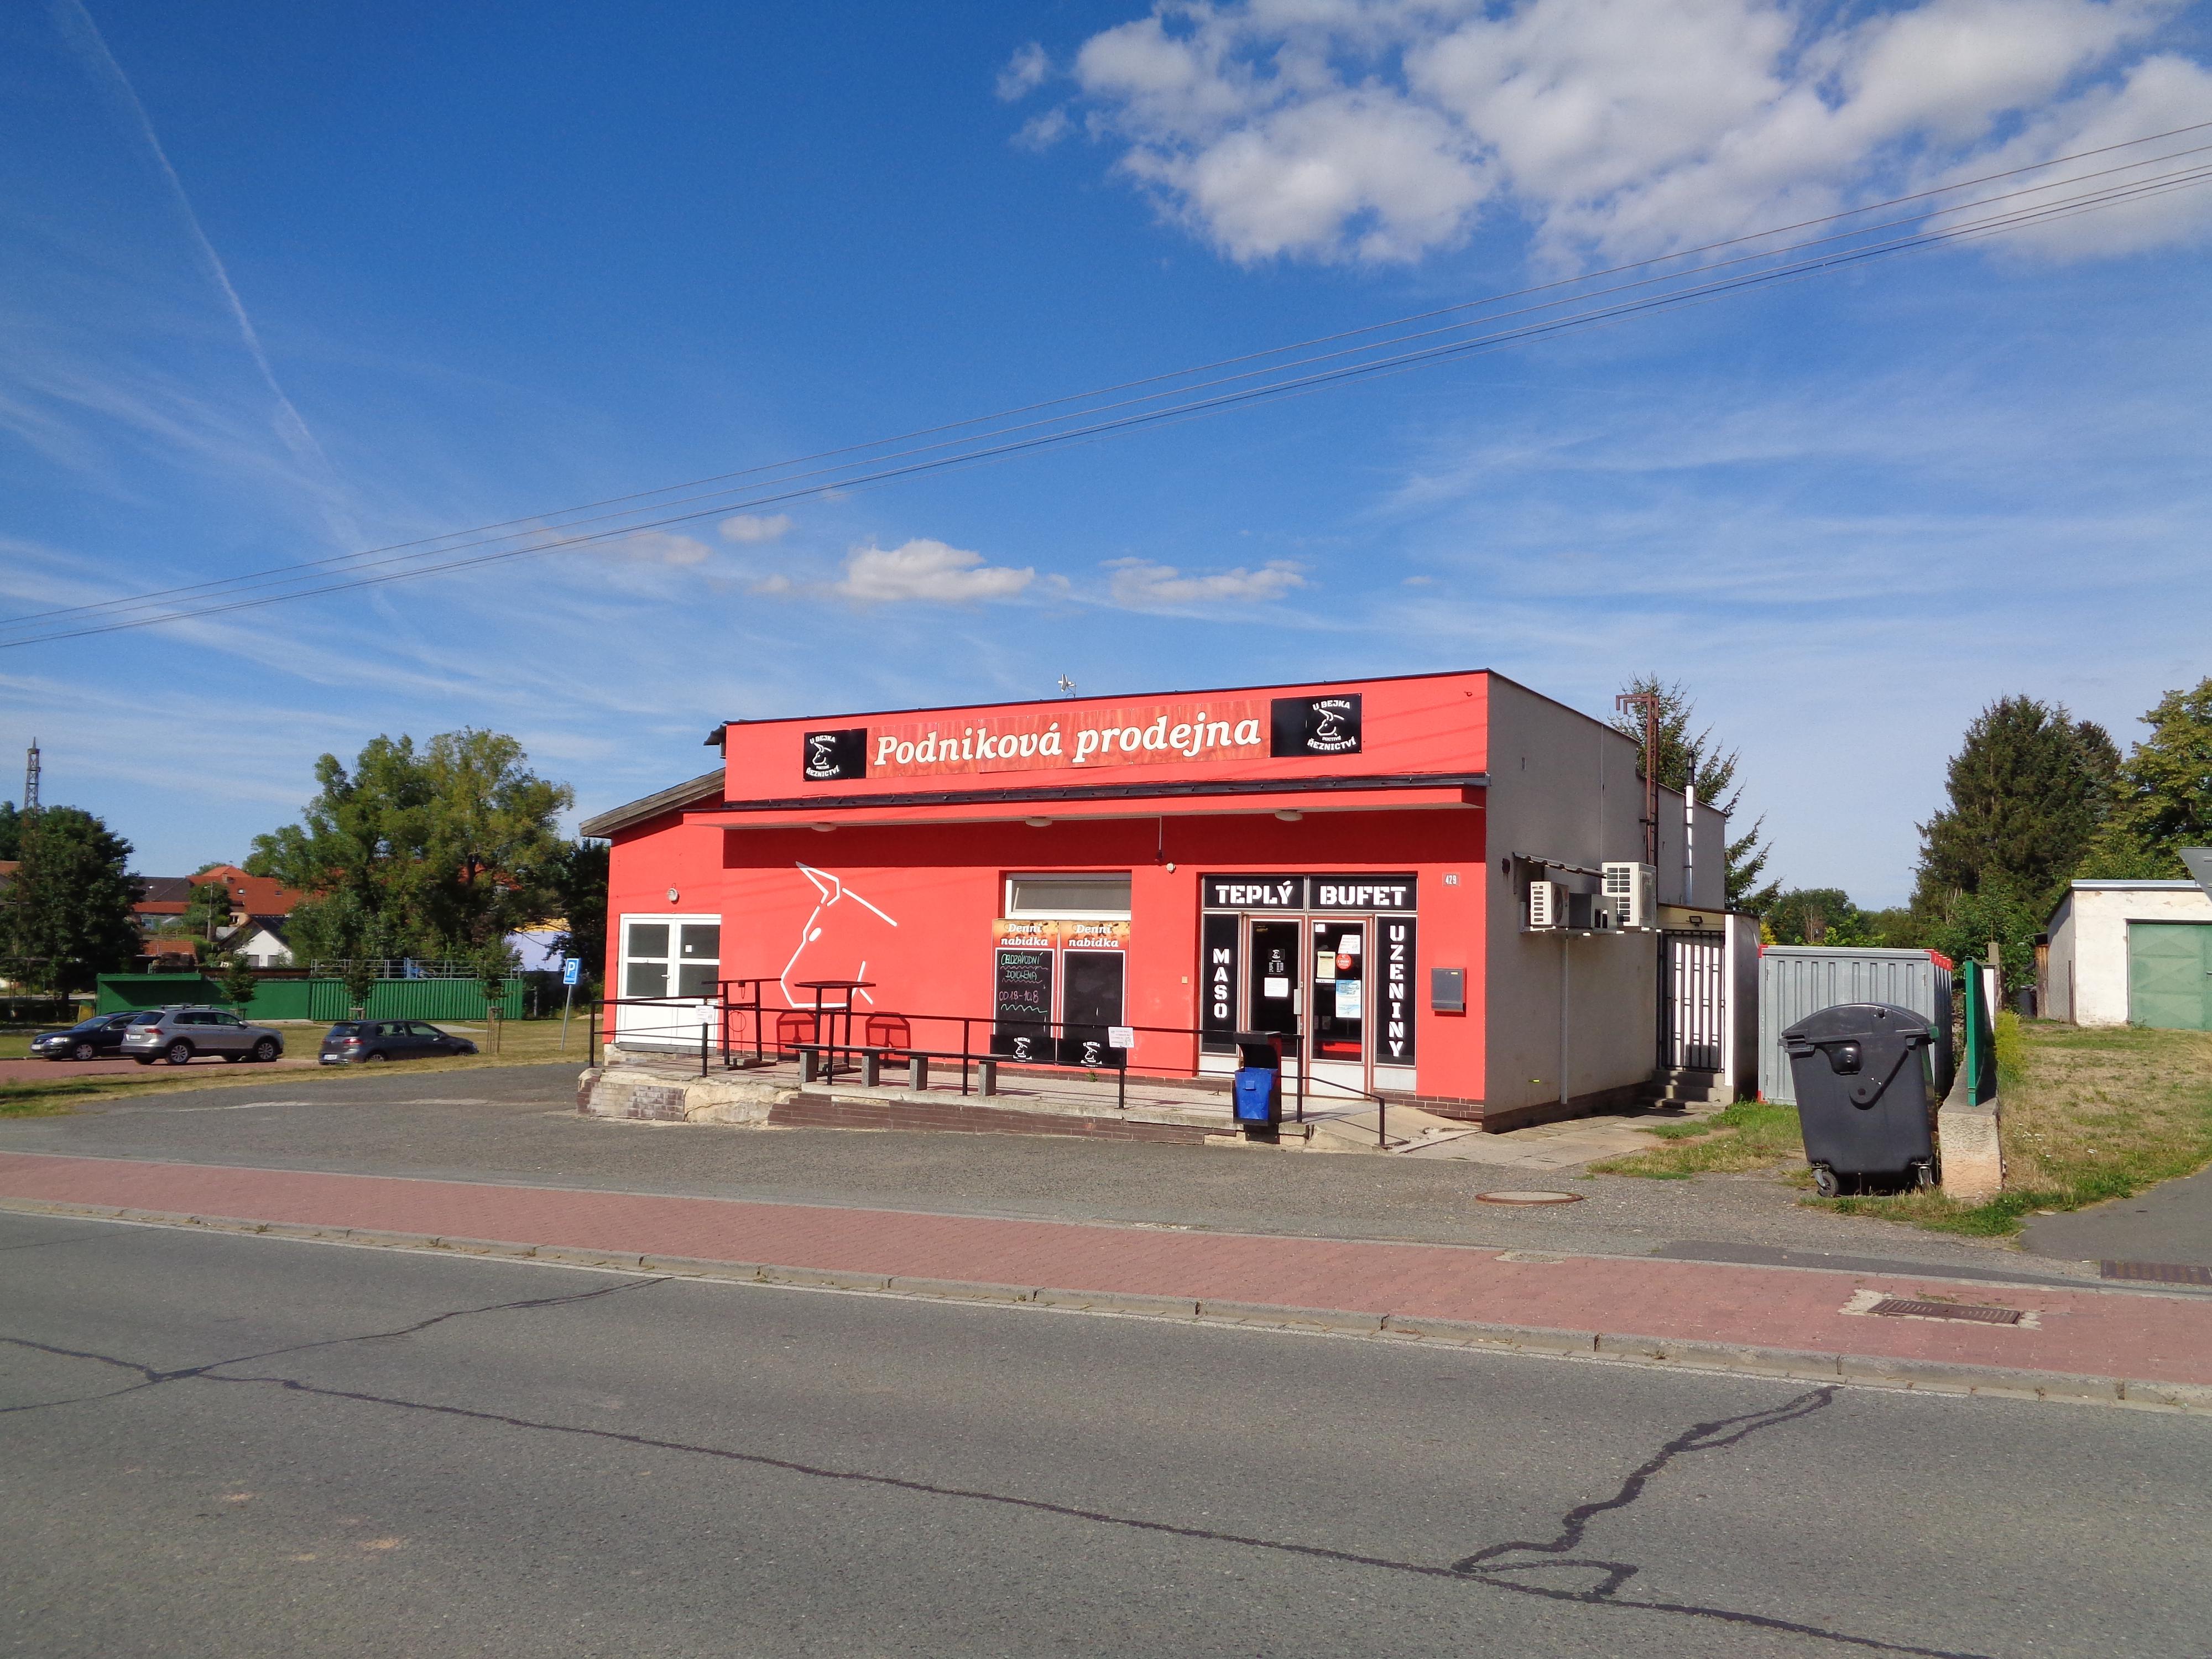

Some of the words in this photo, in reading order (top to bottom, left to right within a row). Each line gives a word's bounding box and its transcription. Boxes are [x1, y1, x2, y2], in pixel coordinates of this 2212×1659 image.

[1321, 700, 1350, 709] BEJKA
[874, 722, 1062, 766] Podniková
[1072, 711, 1261, 763] prodejna
[1307, 736, 1356, 750] ŘEZNICTVÍ
[806, 765, 839, 777] ŘEZNICTVÍ
[1445, 875, 1457, 884] 429
[1215, 880, 1293, 904] TEPLÝ
[1319, 886, 1407, 905] BUFET
[567, 962, 576, 976] P
[1213, 948, 1230, 1018] MASO
[999, 991, 1009, 1001] OD
[1389, 925, 1405, 1057] UZENINY
